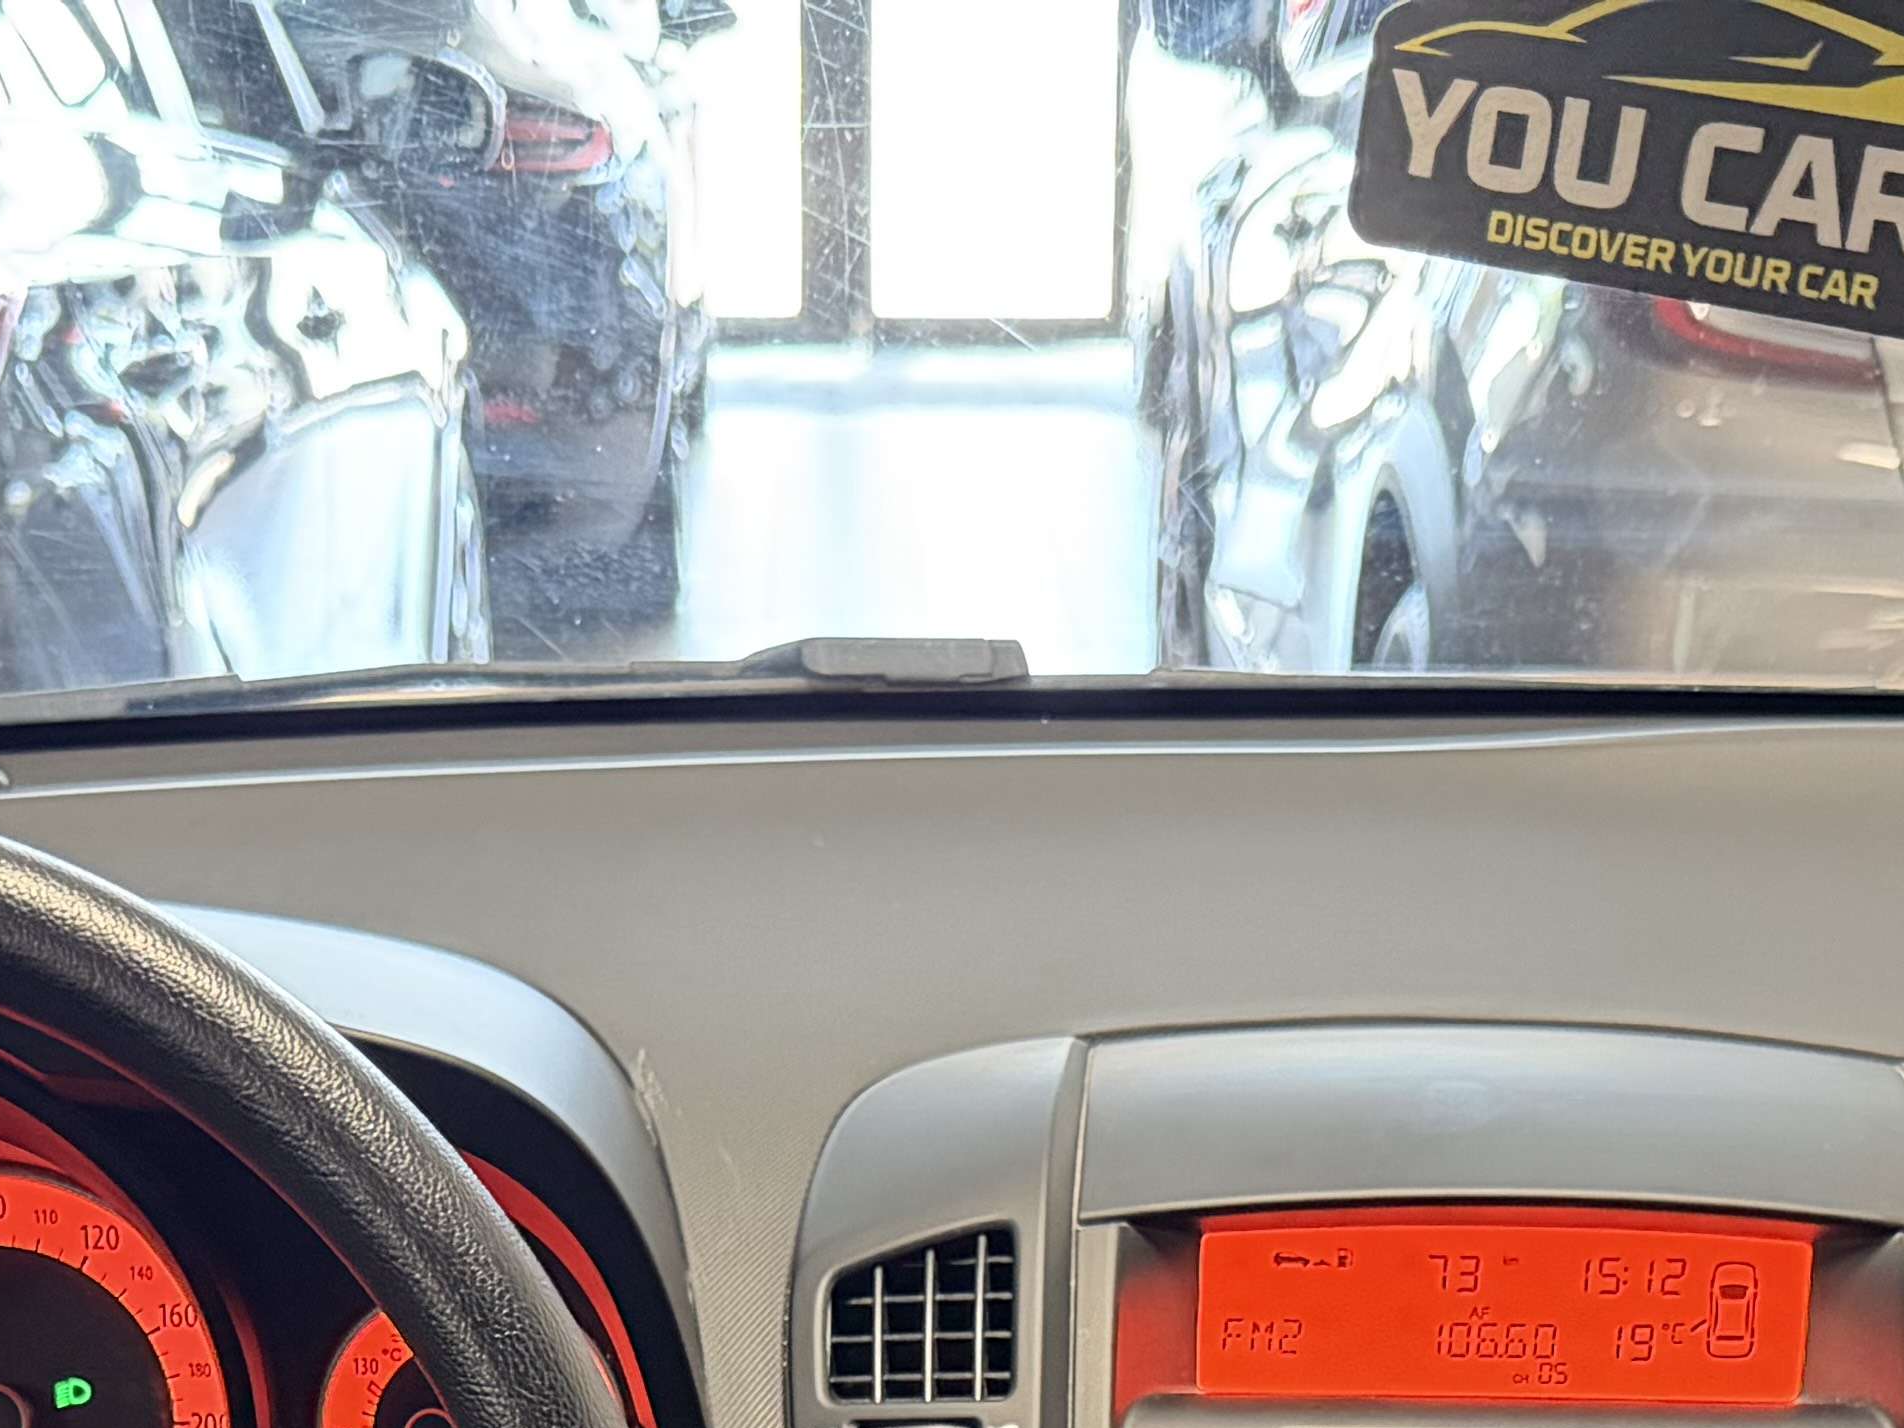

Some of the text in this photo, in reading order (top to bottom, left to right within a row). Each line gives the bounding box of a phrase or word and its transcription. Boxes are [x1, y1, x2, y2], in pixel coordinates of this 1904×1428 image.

[1392, 68, 1648, 209] YOU
[1487, 210, 1879, 311] DISCOVER YOUR CAR
[34, 1209, 58, 1224] 110
[80, 1224, 120, 1250] 120
[129, 1265, 153, 1281] 140
[1429, 1255, 1480, 1292] 73
[1584, 1257, 1687, 1296] 15:12
[158, 1303, 198, 1328] 160
[1469, 1306, 1491, 1319] AF
[1222, 1318, 1303, 1355] FM2
[353, 1358, 379, 1375] 130
